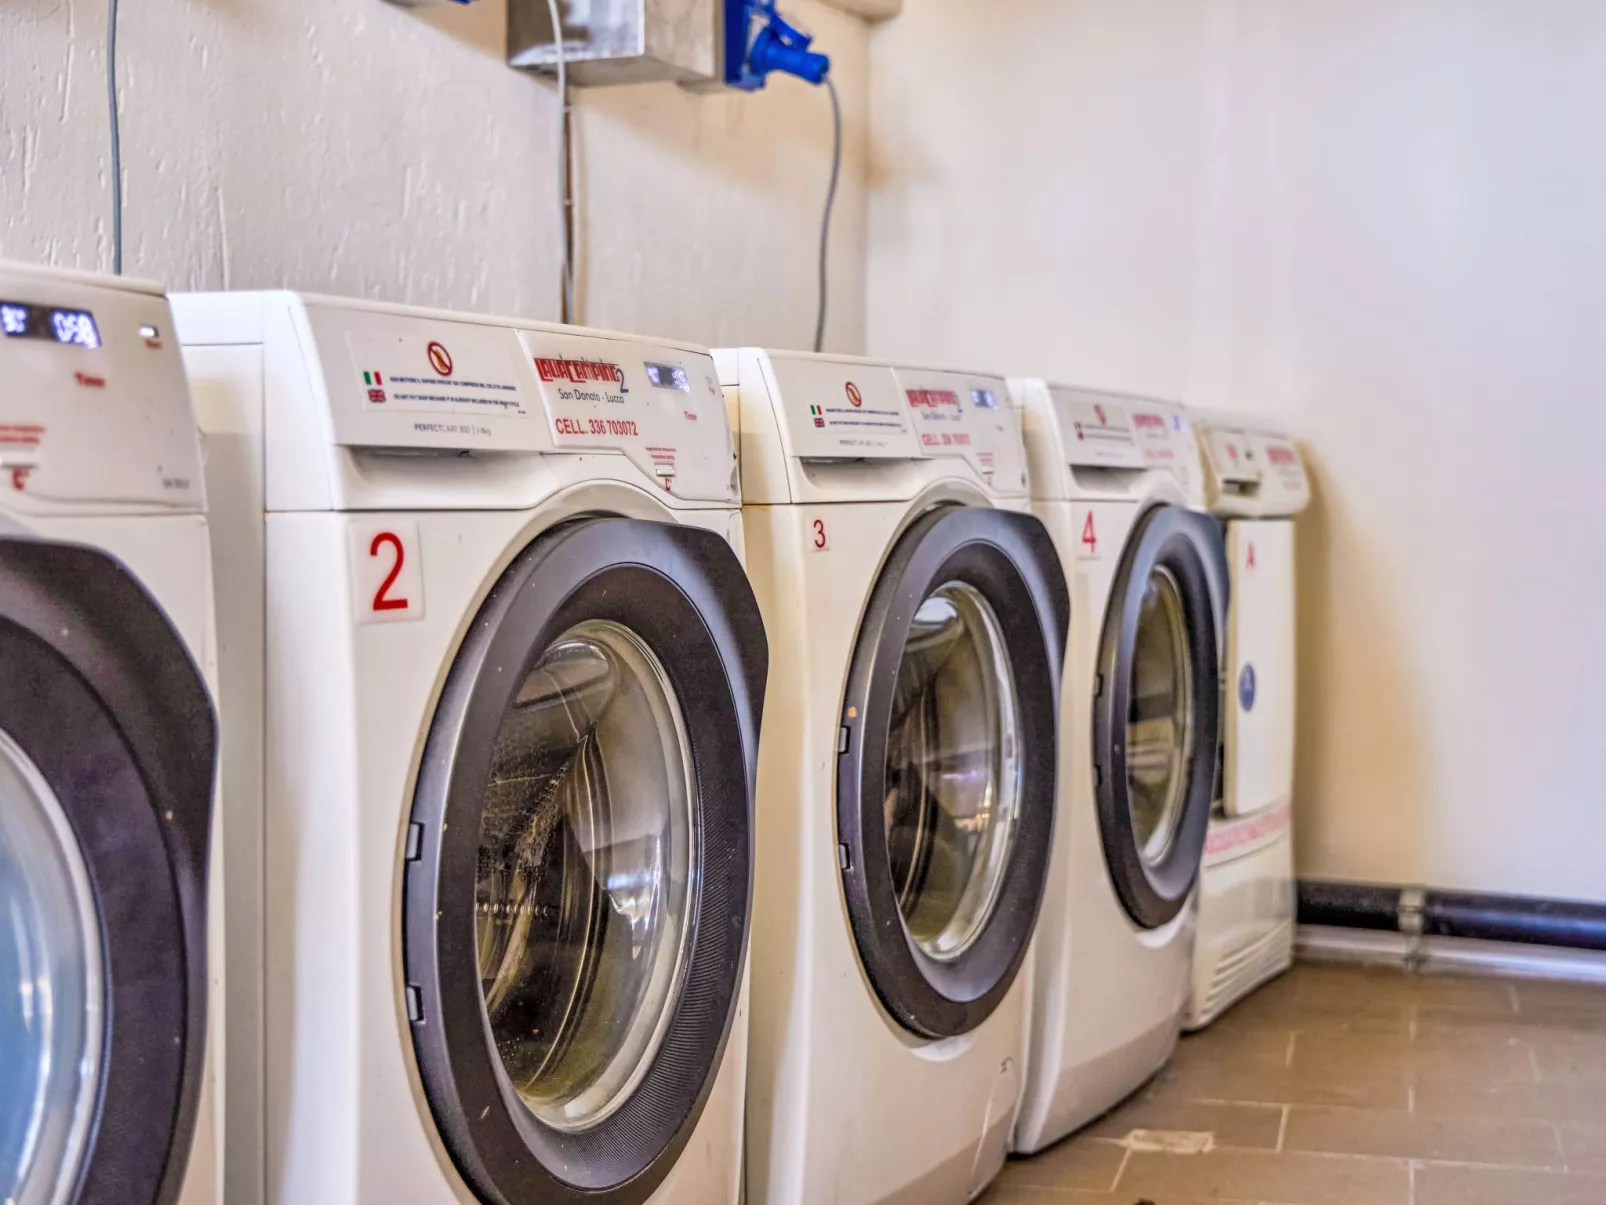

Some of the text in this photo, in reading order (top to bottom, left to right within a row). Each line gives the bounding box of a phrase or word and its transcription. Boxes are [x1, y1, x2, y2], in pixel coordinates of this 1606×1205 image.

[558, 388, 574, 400] San
[574, 389, 601, 402] Donato
[605, 392, 625, 404] Lucca
[555, 419, 638, 436] CELL. 336 703072
[813, 519, 826, 549] 3
[1082, 509, 1097, 553] 4
[370, 532, 408, 611] 2
